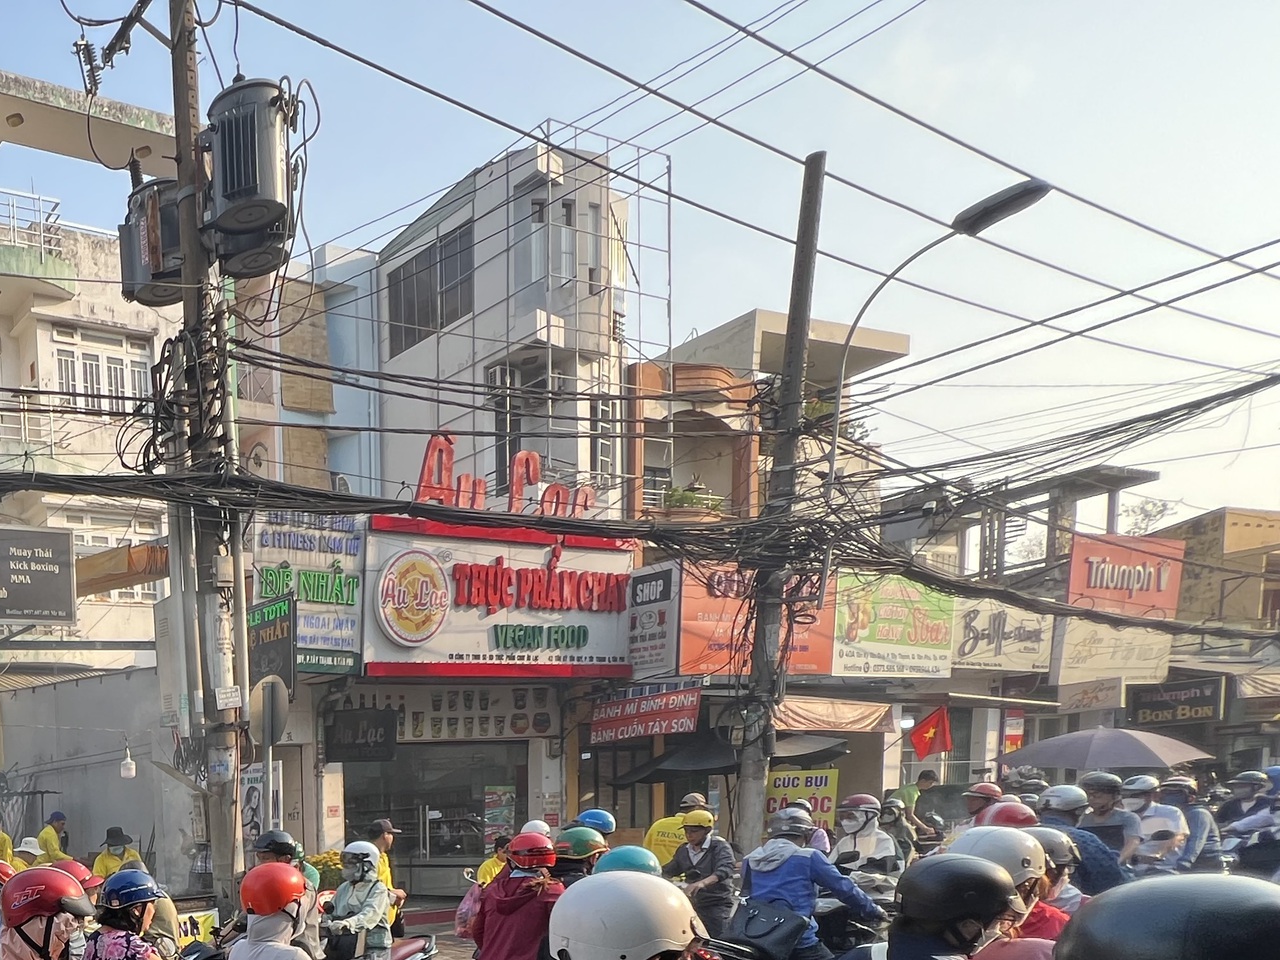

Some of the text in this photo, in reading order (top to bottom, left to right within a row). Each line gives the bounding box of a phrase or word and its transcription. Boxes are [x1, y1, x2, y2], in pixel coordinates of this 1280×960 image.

[273, 531, 316, 551] FITNESS
[9, 547, 32, 558] Muay
[9, 560, 59, 574] Kick Boxing
[10, 574, 31, 584] MMA
[451, 555, 515, 615] THỰC
[578, 570, 631, 613] CHAY
[1086, 556, 1155, 599] Triumph
[381, 571, 449, 615] Âu Lạc
[636, 579, 664, 603] SHOP
[493, 623, 590, 650] VEGAN FOOD
[668, 692, 698, 710] ĐỊNH
[1137, 704, 1214, 724] BON BON
[647, 718, 668, 734] TÂY
[670, 717, 694, 732] SƠN
[773, 774, 828, 790] CÚC BỤI
[807, 792, 832, 813] ÓC
[656, 830, 685, 841] TRUNG
